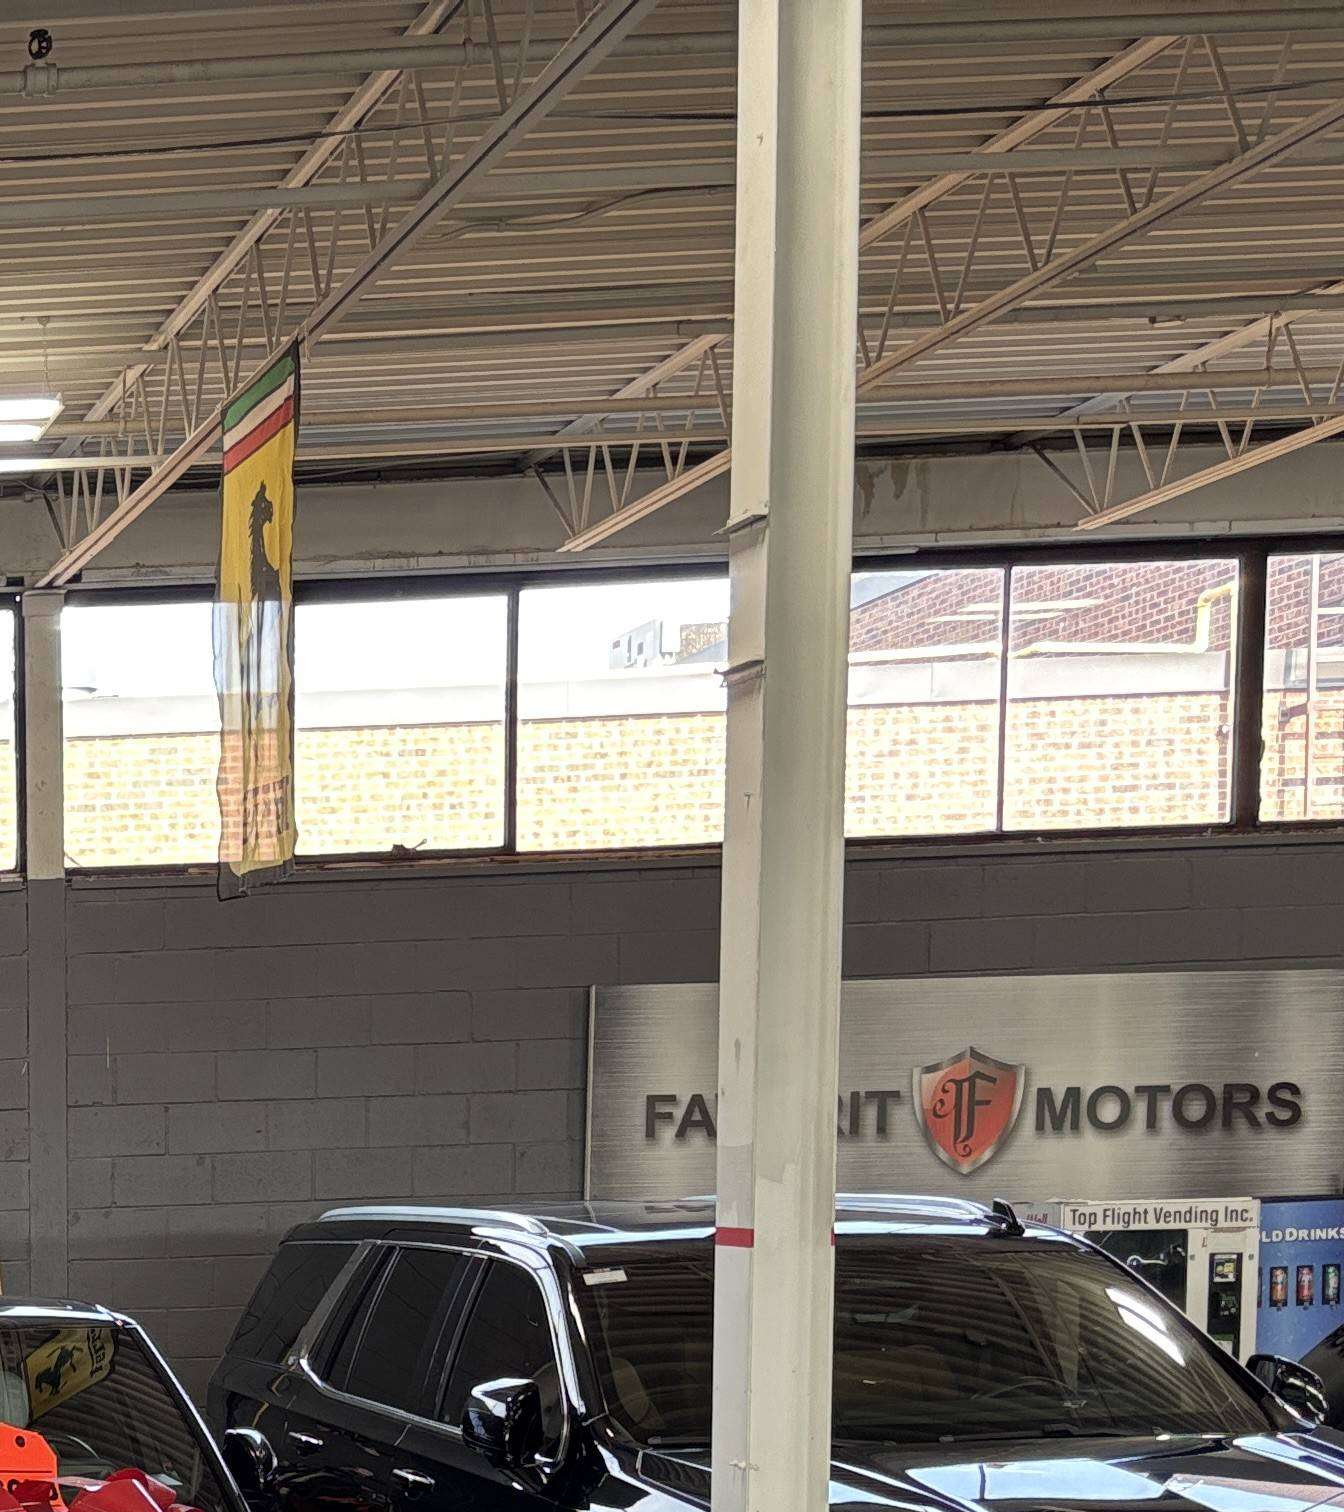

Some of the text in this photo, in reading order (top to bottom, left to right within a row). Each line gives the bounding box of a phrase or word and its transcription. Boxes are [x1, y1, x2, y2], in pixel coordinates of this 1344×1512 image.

[1035, 1082, 1303, 1131] MOTORS
[1069, 1208, 1097, 1228] Top
[1102, 1207, 1148, 1228] Flight
[1154, 1206, 1219, 1225] Vending
[1224, 1206, 1254, 1223] Inc.
